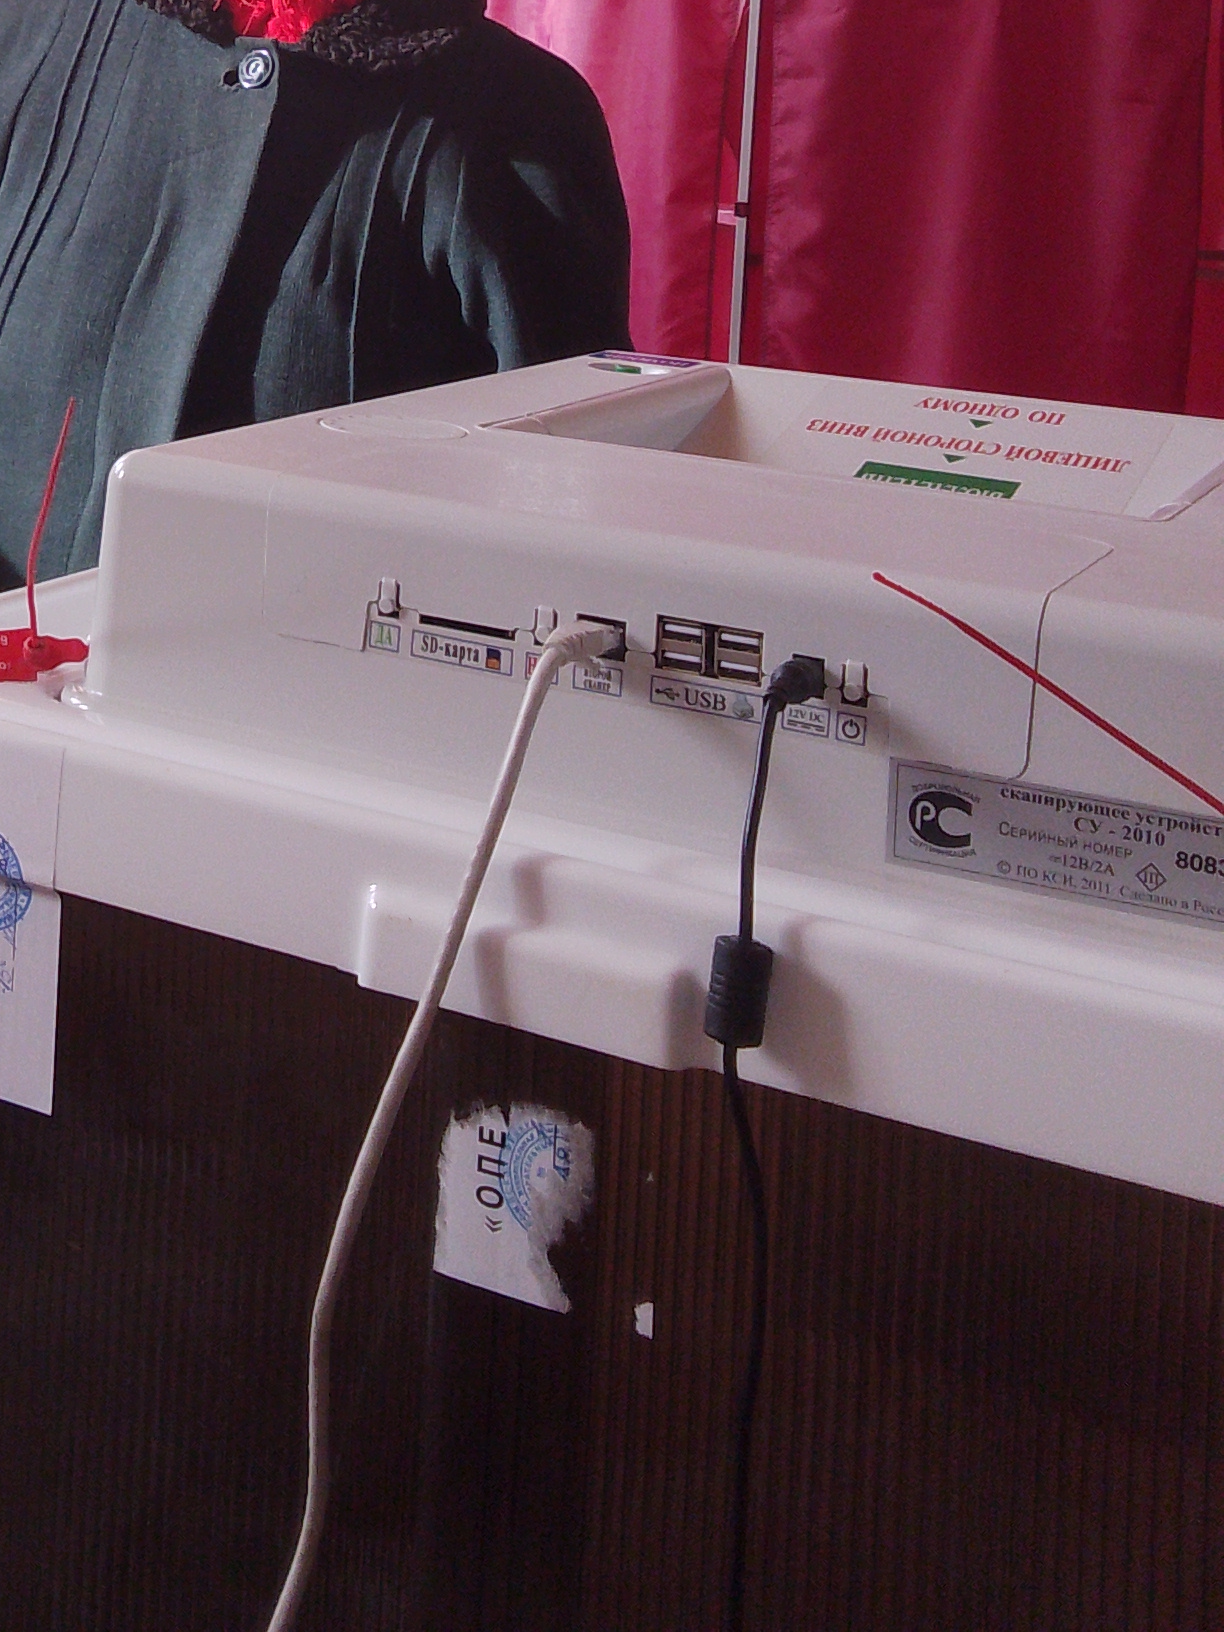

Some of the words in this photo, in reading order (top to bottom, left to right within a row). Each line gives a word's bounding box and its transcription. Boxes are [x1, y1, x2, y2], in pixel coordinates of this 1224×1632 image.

[914, 396, 1020, 419] ОДНОМУ
[1028, 410, 1066, 426] ПО
[806, 418, 871, 439] ВНИЗ
[872, 427, 1003, 455] СТОРОНОЙ
[1005, 445, 1132, 473] ЛИЦЕВОЙ
[375, 625, 393, 646] ДА
[421, 635, 480, 665] SD-карта
[684, 687, 727, 712] USB
[1000, 787, 1131, 820] сканирующее
[1073, 816, 1102, 834] СУ
[1122, 825, 1166, 847] 2010
